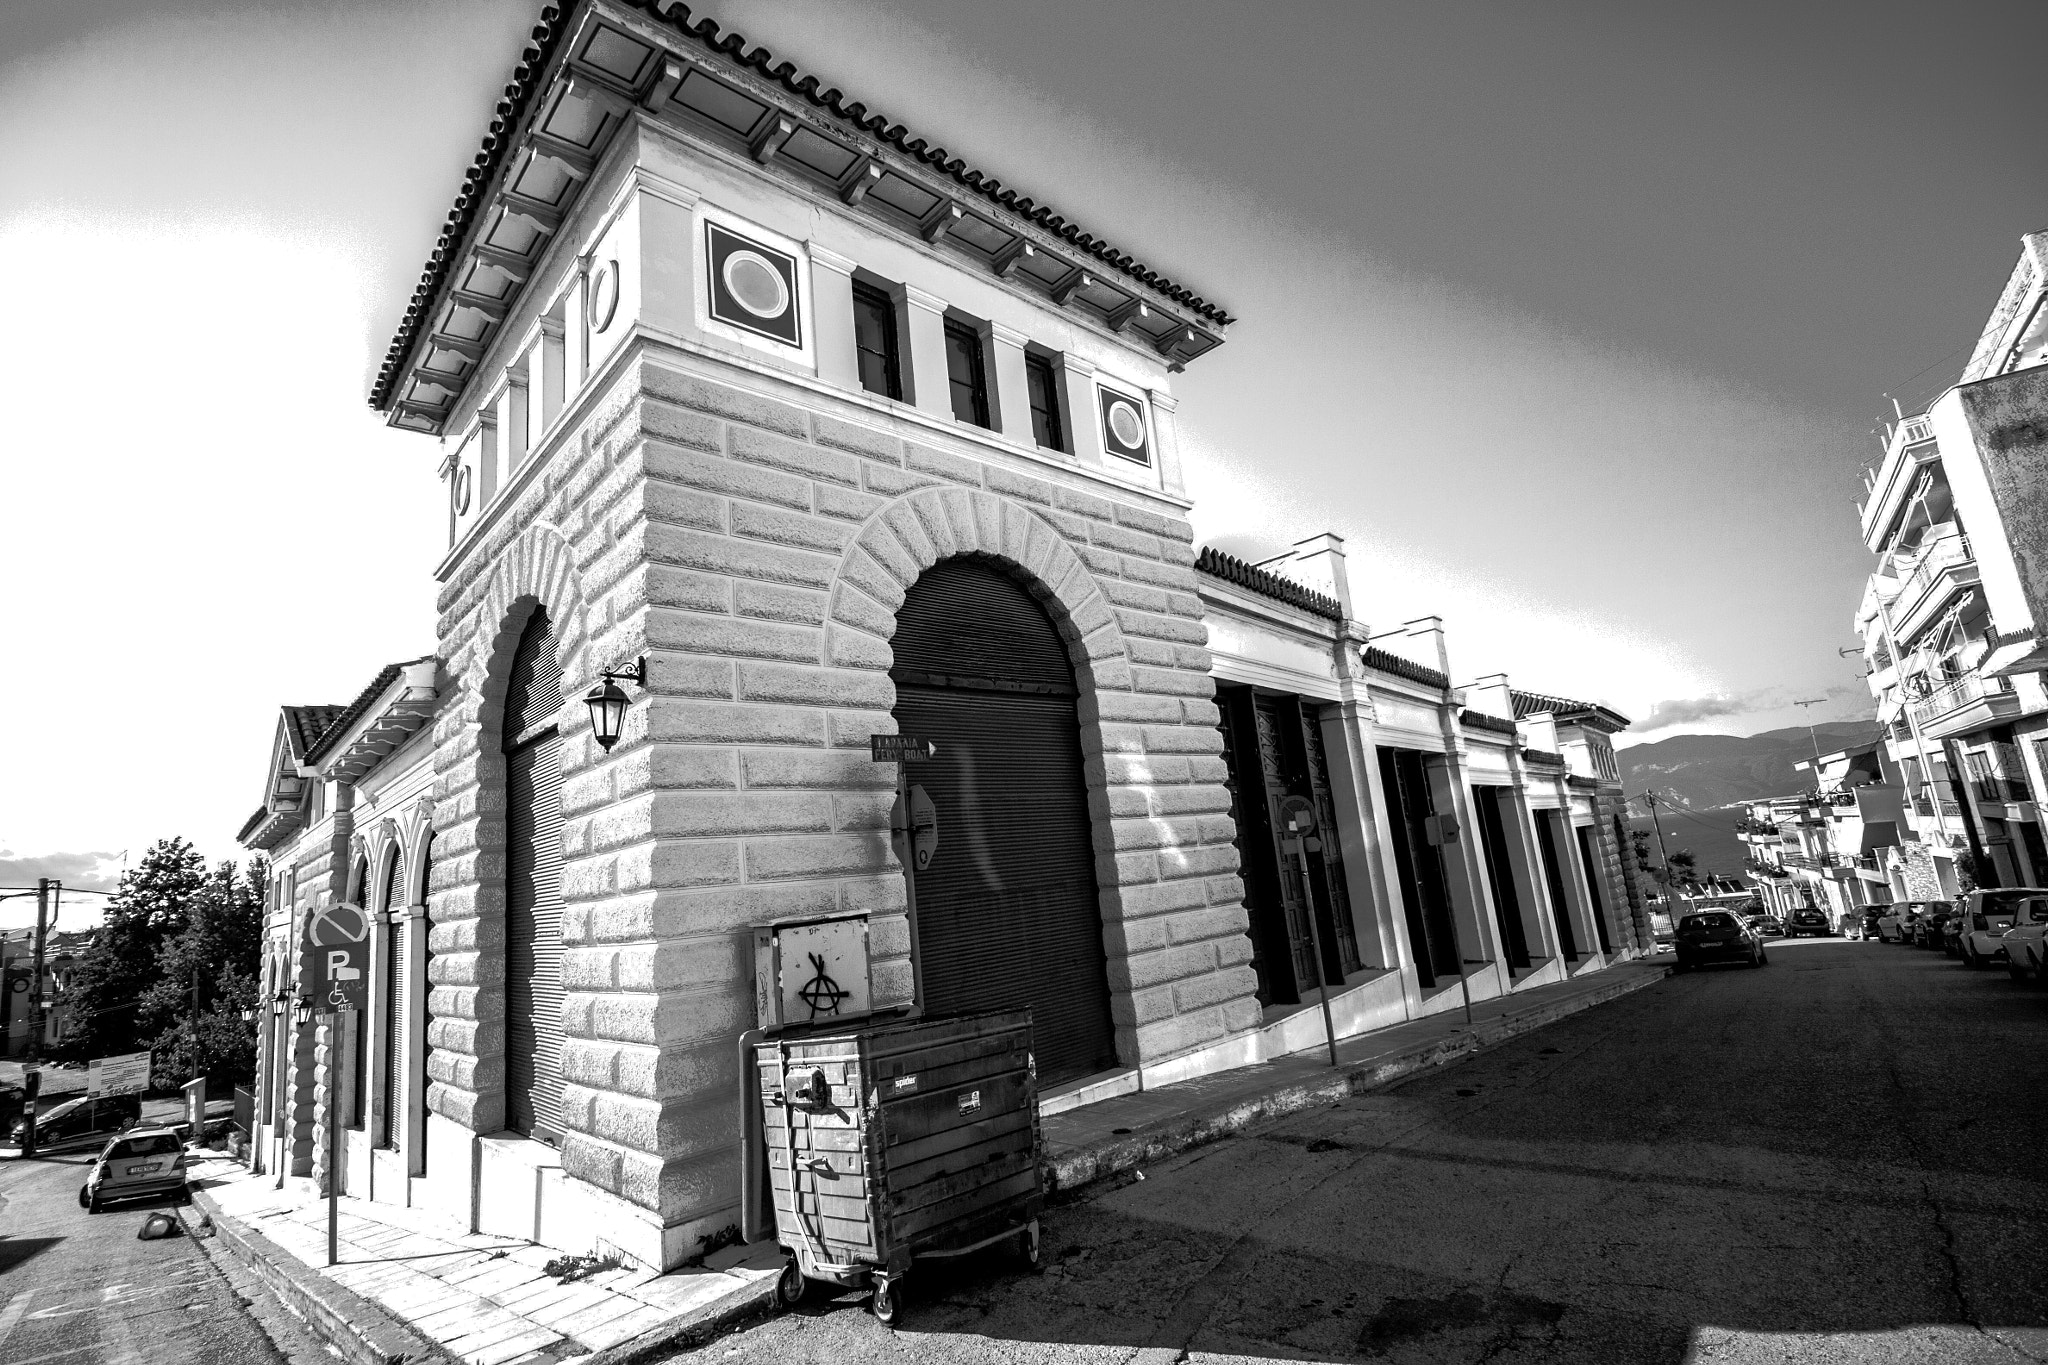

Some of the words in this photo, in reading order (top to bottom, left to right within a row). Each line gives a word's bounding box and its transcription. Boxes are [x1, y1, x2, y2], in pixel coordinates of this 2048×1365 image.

[904, 749, 928, 760] BOAT
[327, 950, 350, 980] P
[895, 1076, 917, 1088] spider
